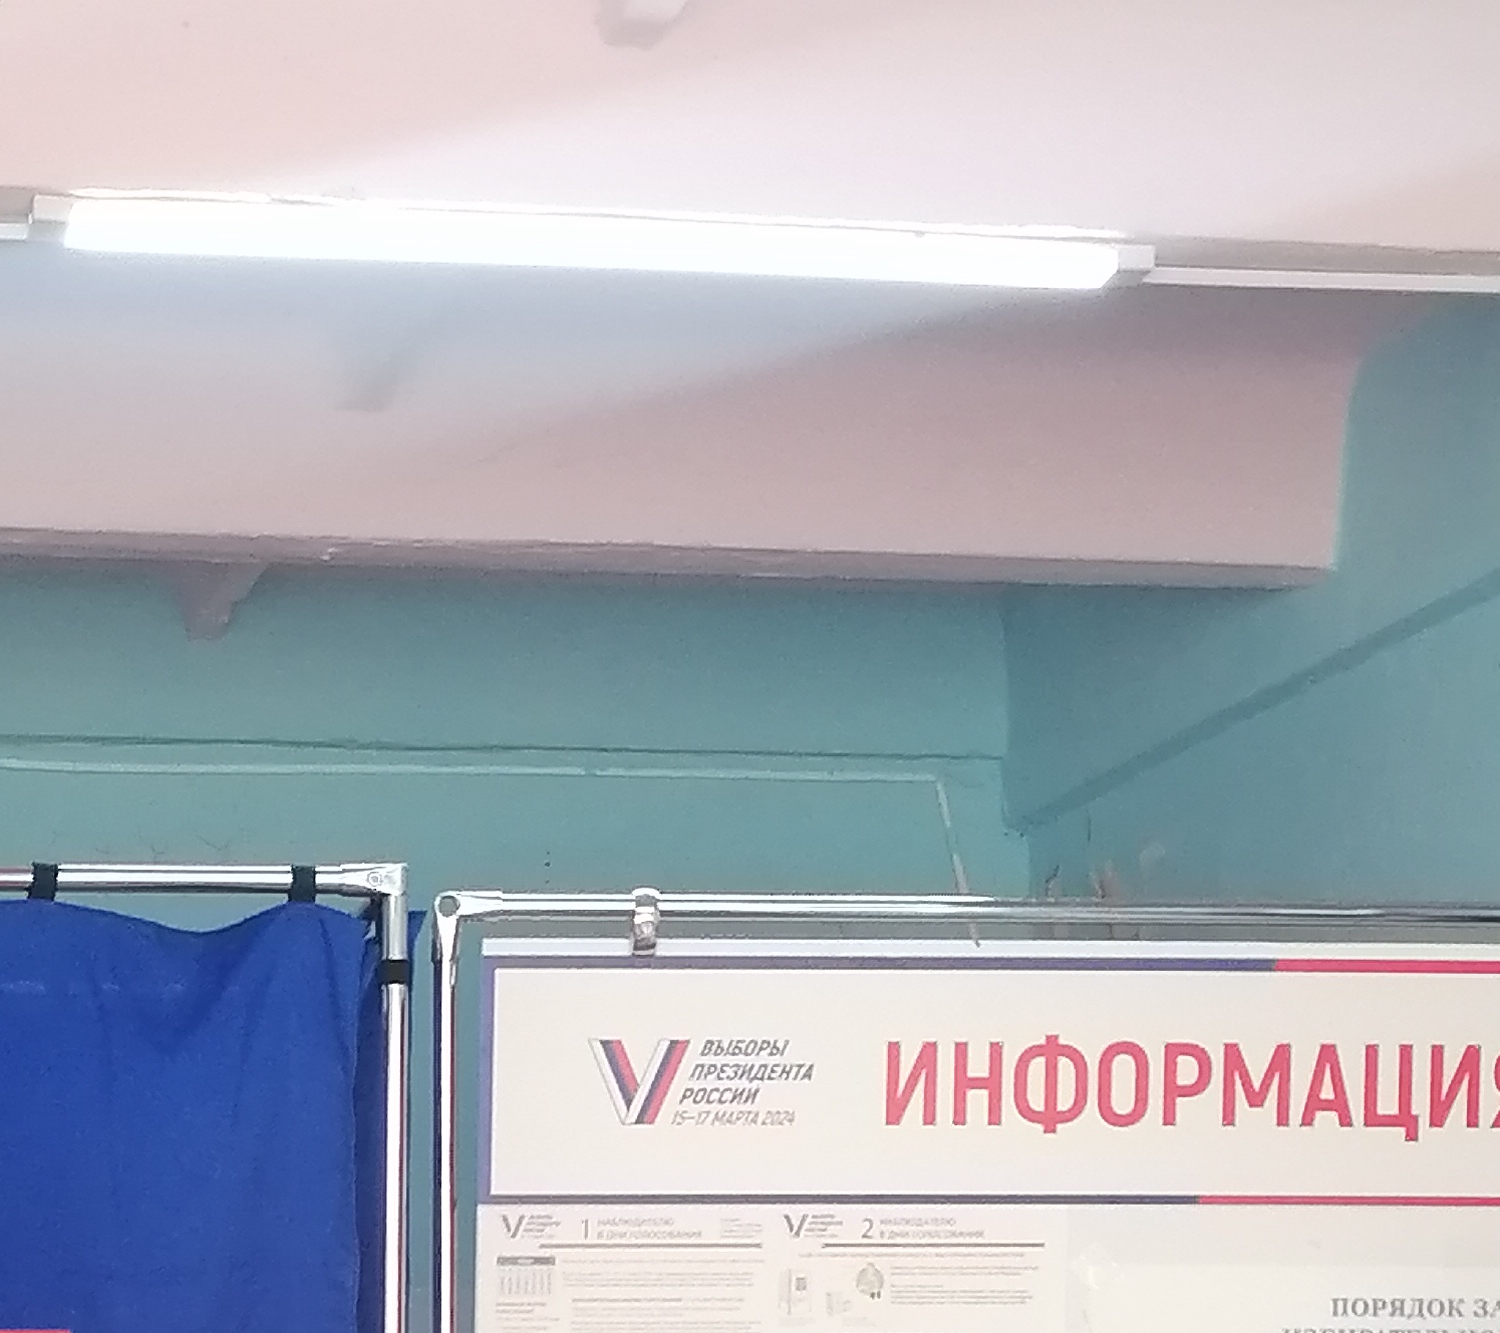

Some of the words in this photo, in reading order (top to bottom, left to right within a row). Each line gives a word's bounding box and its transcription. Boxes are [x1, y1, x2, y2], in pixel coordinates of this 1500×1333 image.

[699, 1039, 790, 1057] ВЫБОРЫ
[688, 1063, 815, 1082] ПРЕЗИДЕНТА
[678, 1087, 760, 1105] РОССИИ
[884, 1034, 1500, 1142] ИНФОРМАЦИ
[711, 1110, 758, 1126] МАРТА
[760, 1110, 796, 1126] 2024
[581, 1218, 589, 1240] 1
[861, 1218, 874, 1239] 2
[1331, 1298, 1466, 1320] ПОРЯДОК
